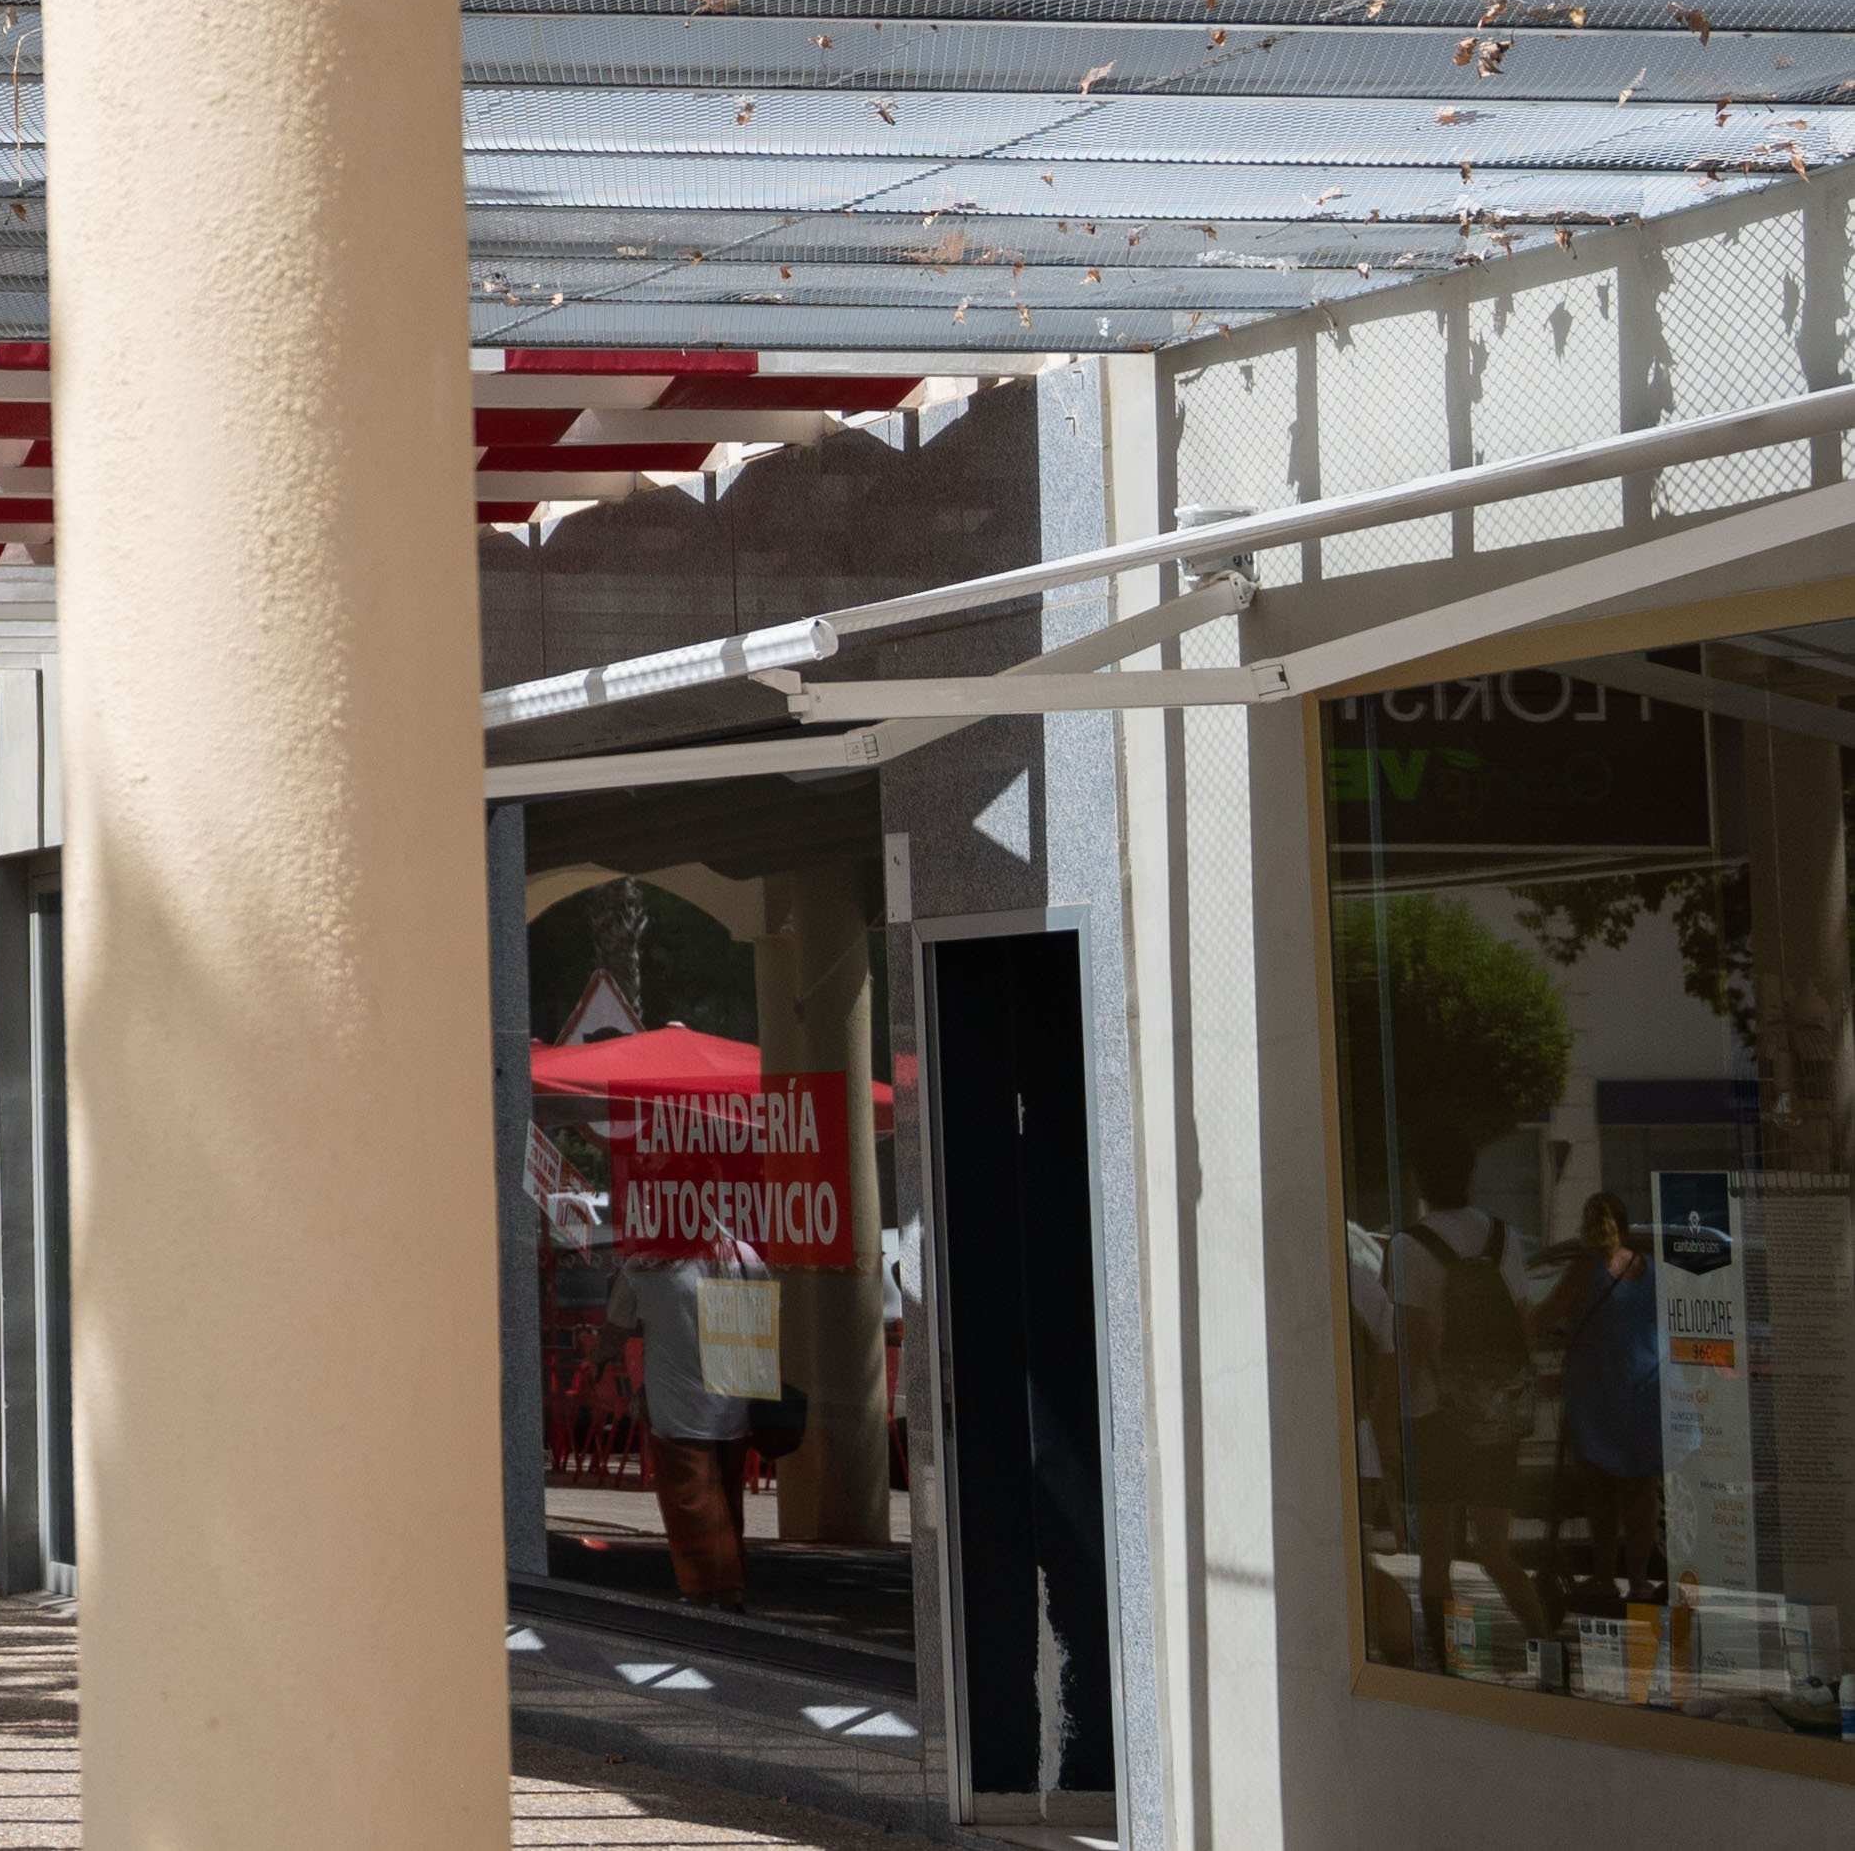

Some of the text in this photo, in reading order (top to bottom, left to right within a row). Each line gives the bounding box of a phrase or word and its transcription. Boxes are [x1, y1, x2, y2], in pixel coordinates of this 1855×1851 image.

[635, 1078, 820, 1153] LAVANDERÍA
[625, 1180, 838, 1245] AUTOSERVICIO
[1667, 1299, 1734, 1335] HELIOCARE
